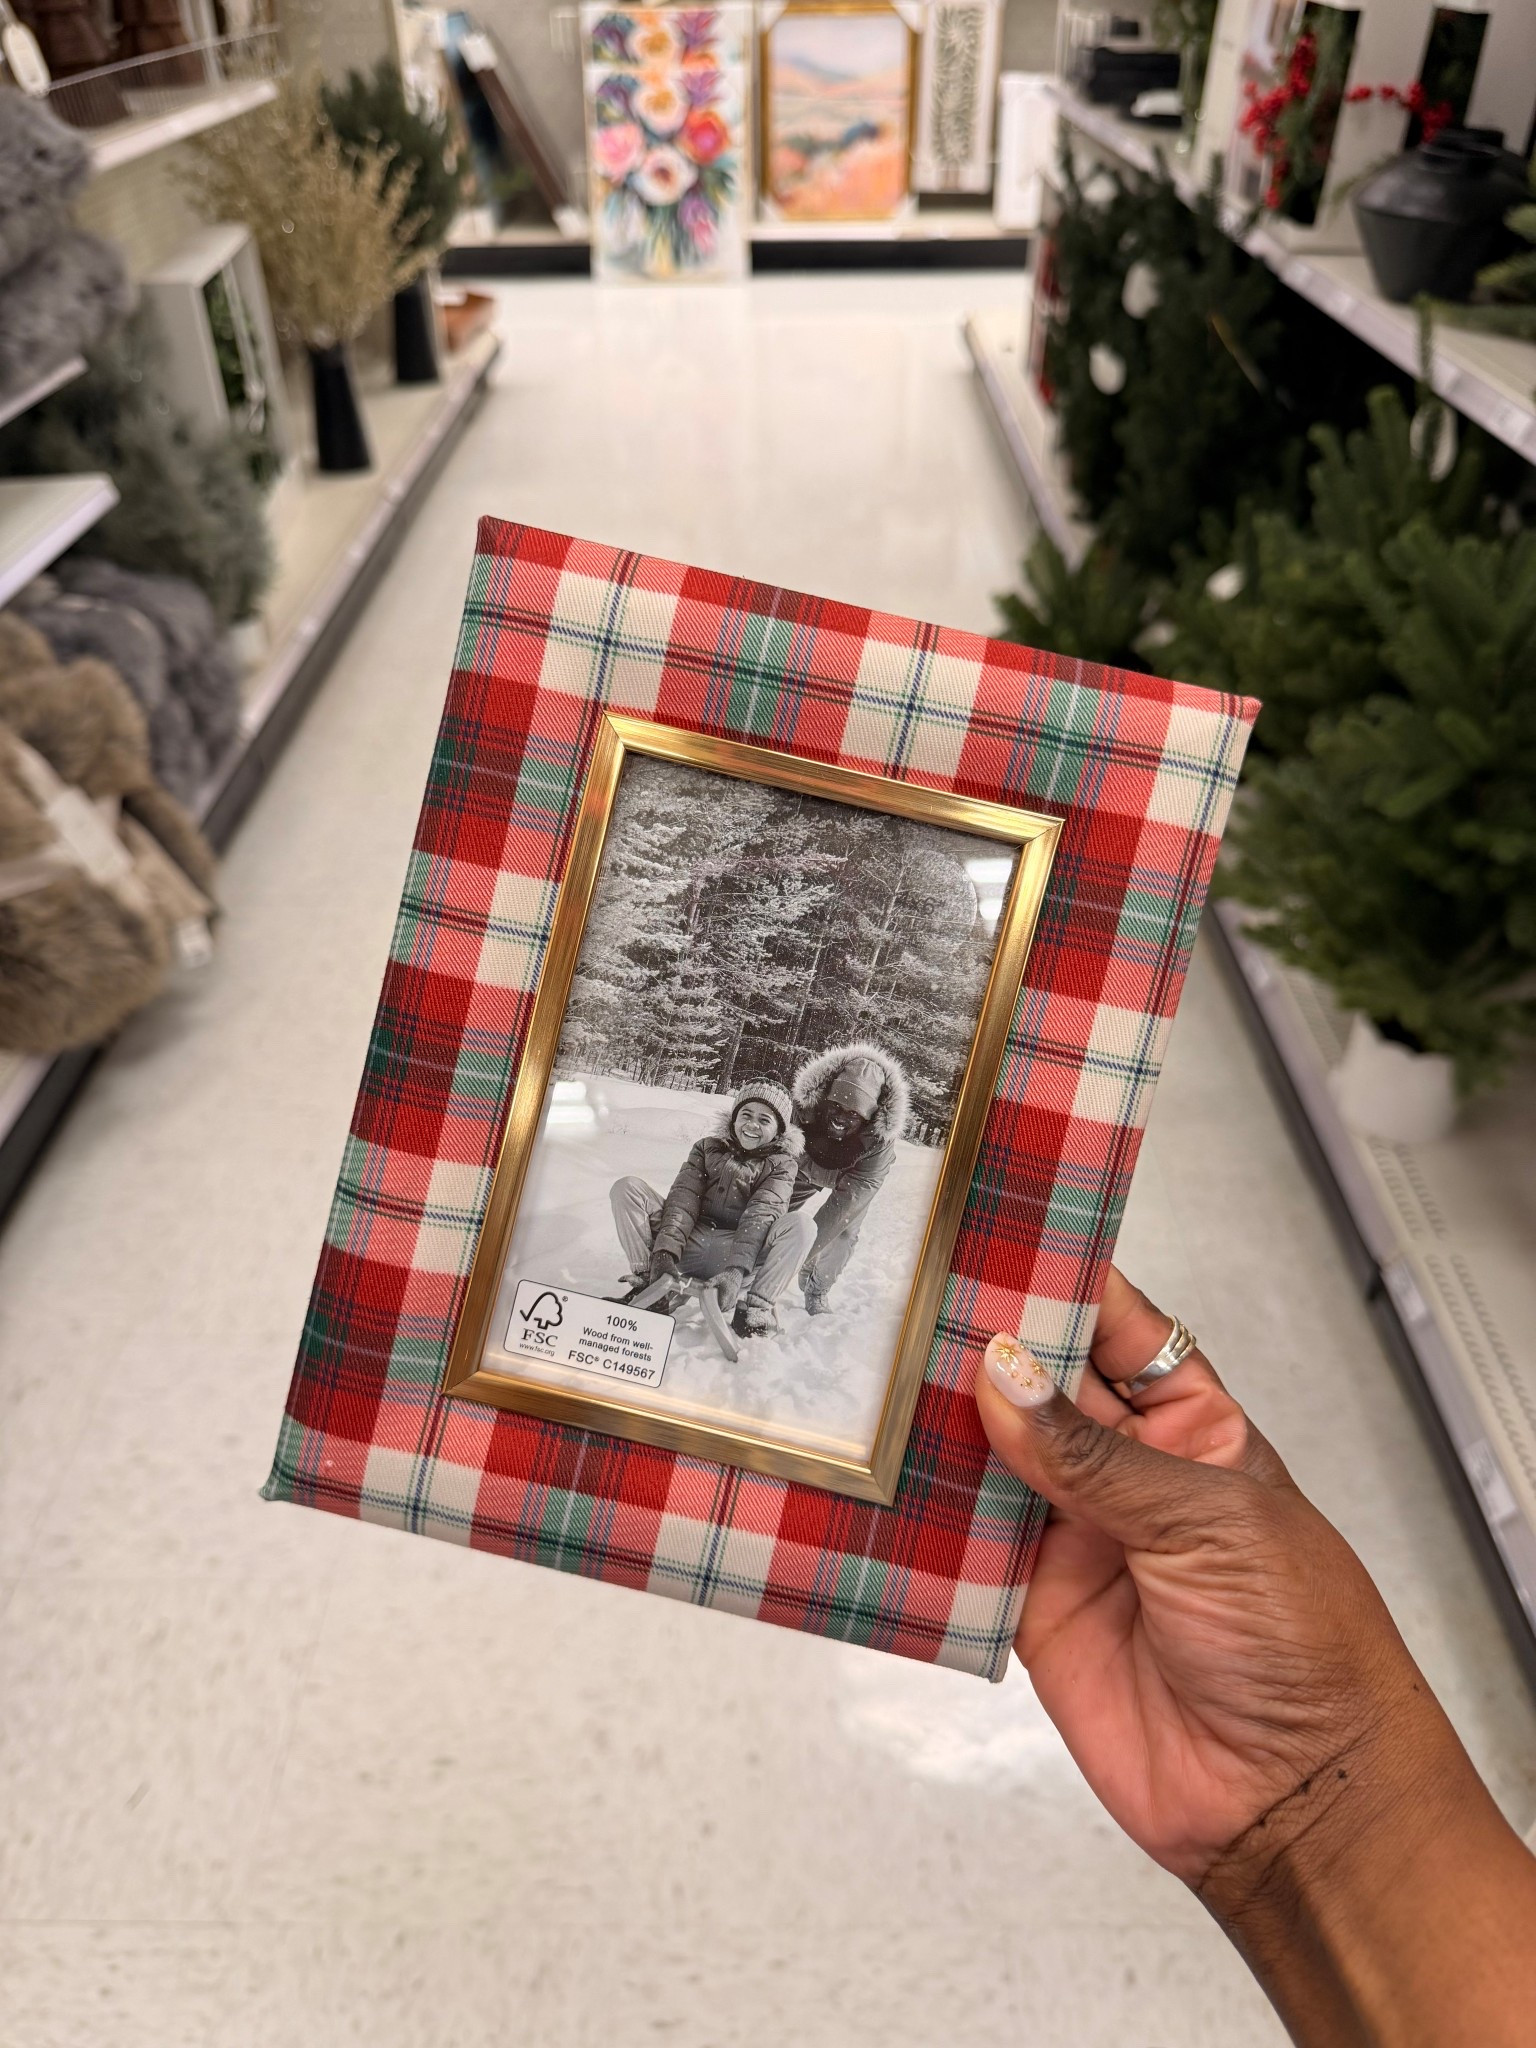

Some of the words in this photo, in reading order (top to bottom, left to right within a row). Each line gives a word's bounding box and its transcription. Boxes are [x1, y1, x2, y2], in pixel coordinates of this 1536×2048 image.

[607, 1315, 638, 1332] 100%
[521, 1328, 558, 1348] FSC
[583, 1326, 608, 1340] Wood
[611, 1333, 630, 1346] from
[633, 1338, 653, 1351] well-
[519, 1343, 555, 1356] www.fsc.org
[579, 1337, 619, 1354] managed
[622, 1348, 652, 1361] forests
[602, 1359, 656, 1380] C149567
